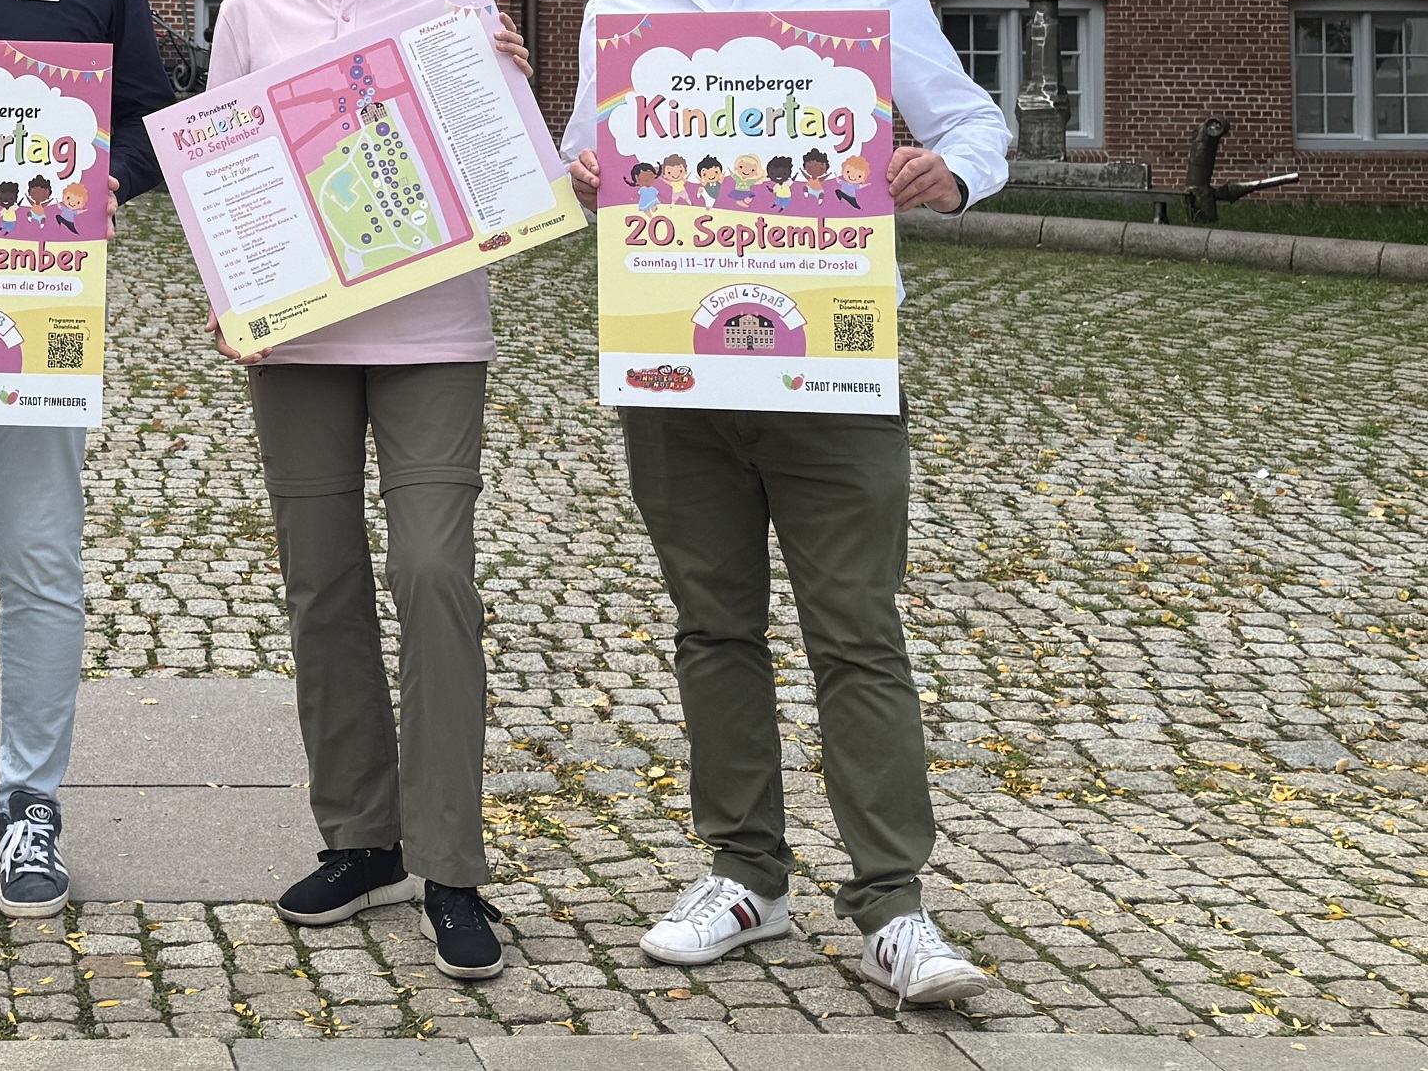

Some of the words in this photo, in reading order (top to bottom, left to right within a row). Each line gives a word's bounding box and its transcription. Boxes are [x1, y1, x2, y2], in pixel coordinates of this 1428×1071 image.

[671, 75, 700, 92] 29.
[706, 74, 813, 95] Pinneberger
[198, 99, 238, 120] Pinneberger
[172, 104, 265, 151] Kindertag
[635, 94, 855, 153] Kindertag
[207, 126, 261, 153] September
[239, 166, 251, 175] Uhr
[624, 215, 683, 247] 20.
[693, 214, 874, 257] September
[633, 257, 677, 270] Sonntag
[718, 258, 738, 268] Uhr
[747, 258, 776, 269] Rund
[799, 259, 815, 270] die
[818, 259, 858, 270] Drostei
[19, 281, 34, 290] die
[37, 281, 72, 291] Drostei
[709, 287, 739, 308] Spiel
[752, 286, 785, 308] Spaß
[805, 381, 830, 392] STADT
[832, 382, 881, 393] PINNEBERG
[19, 396, 42, 406] STADT
[43, 397, 87, 407] PINNEBERG
